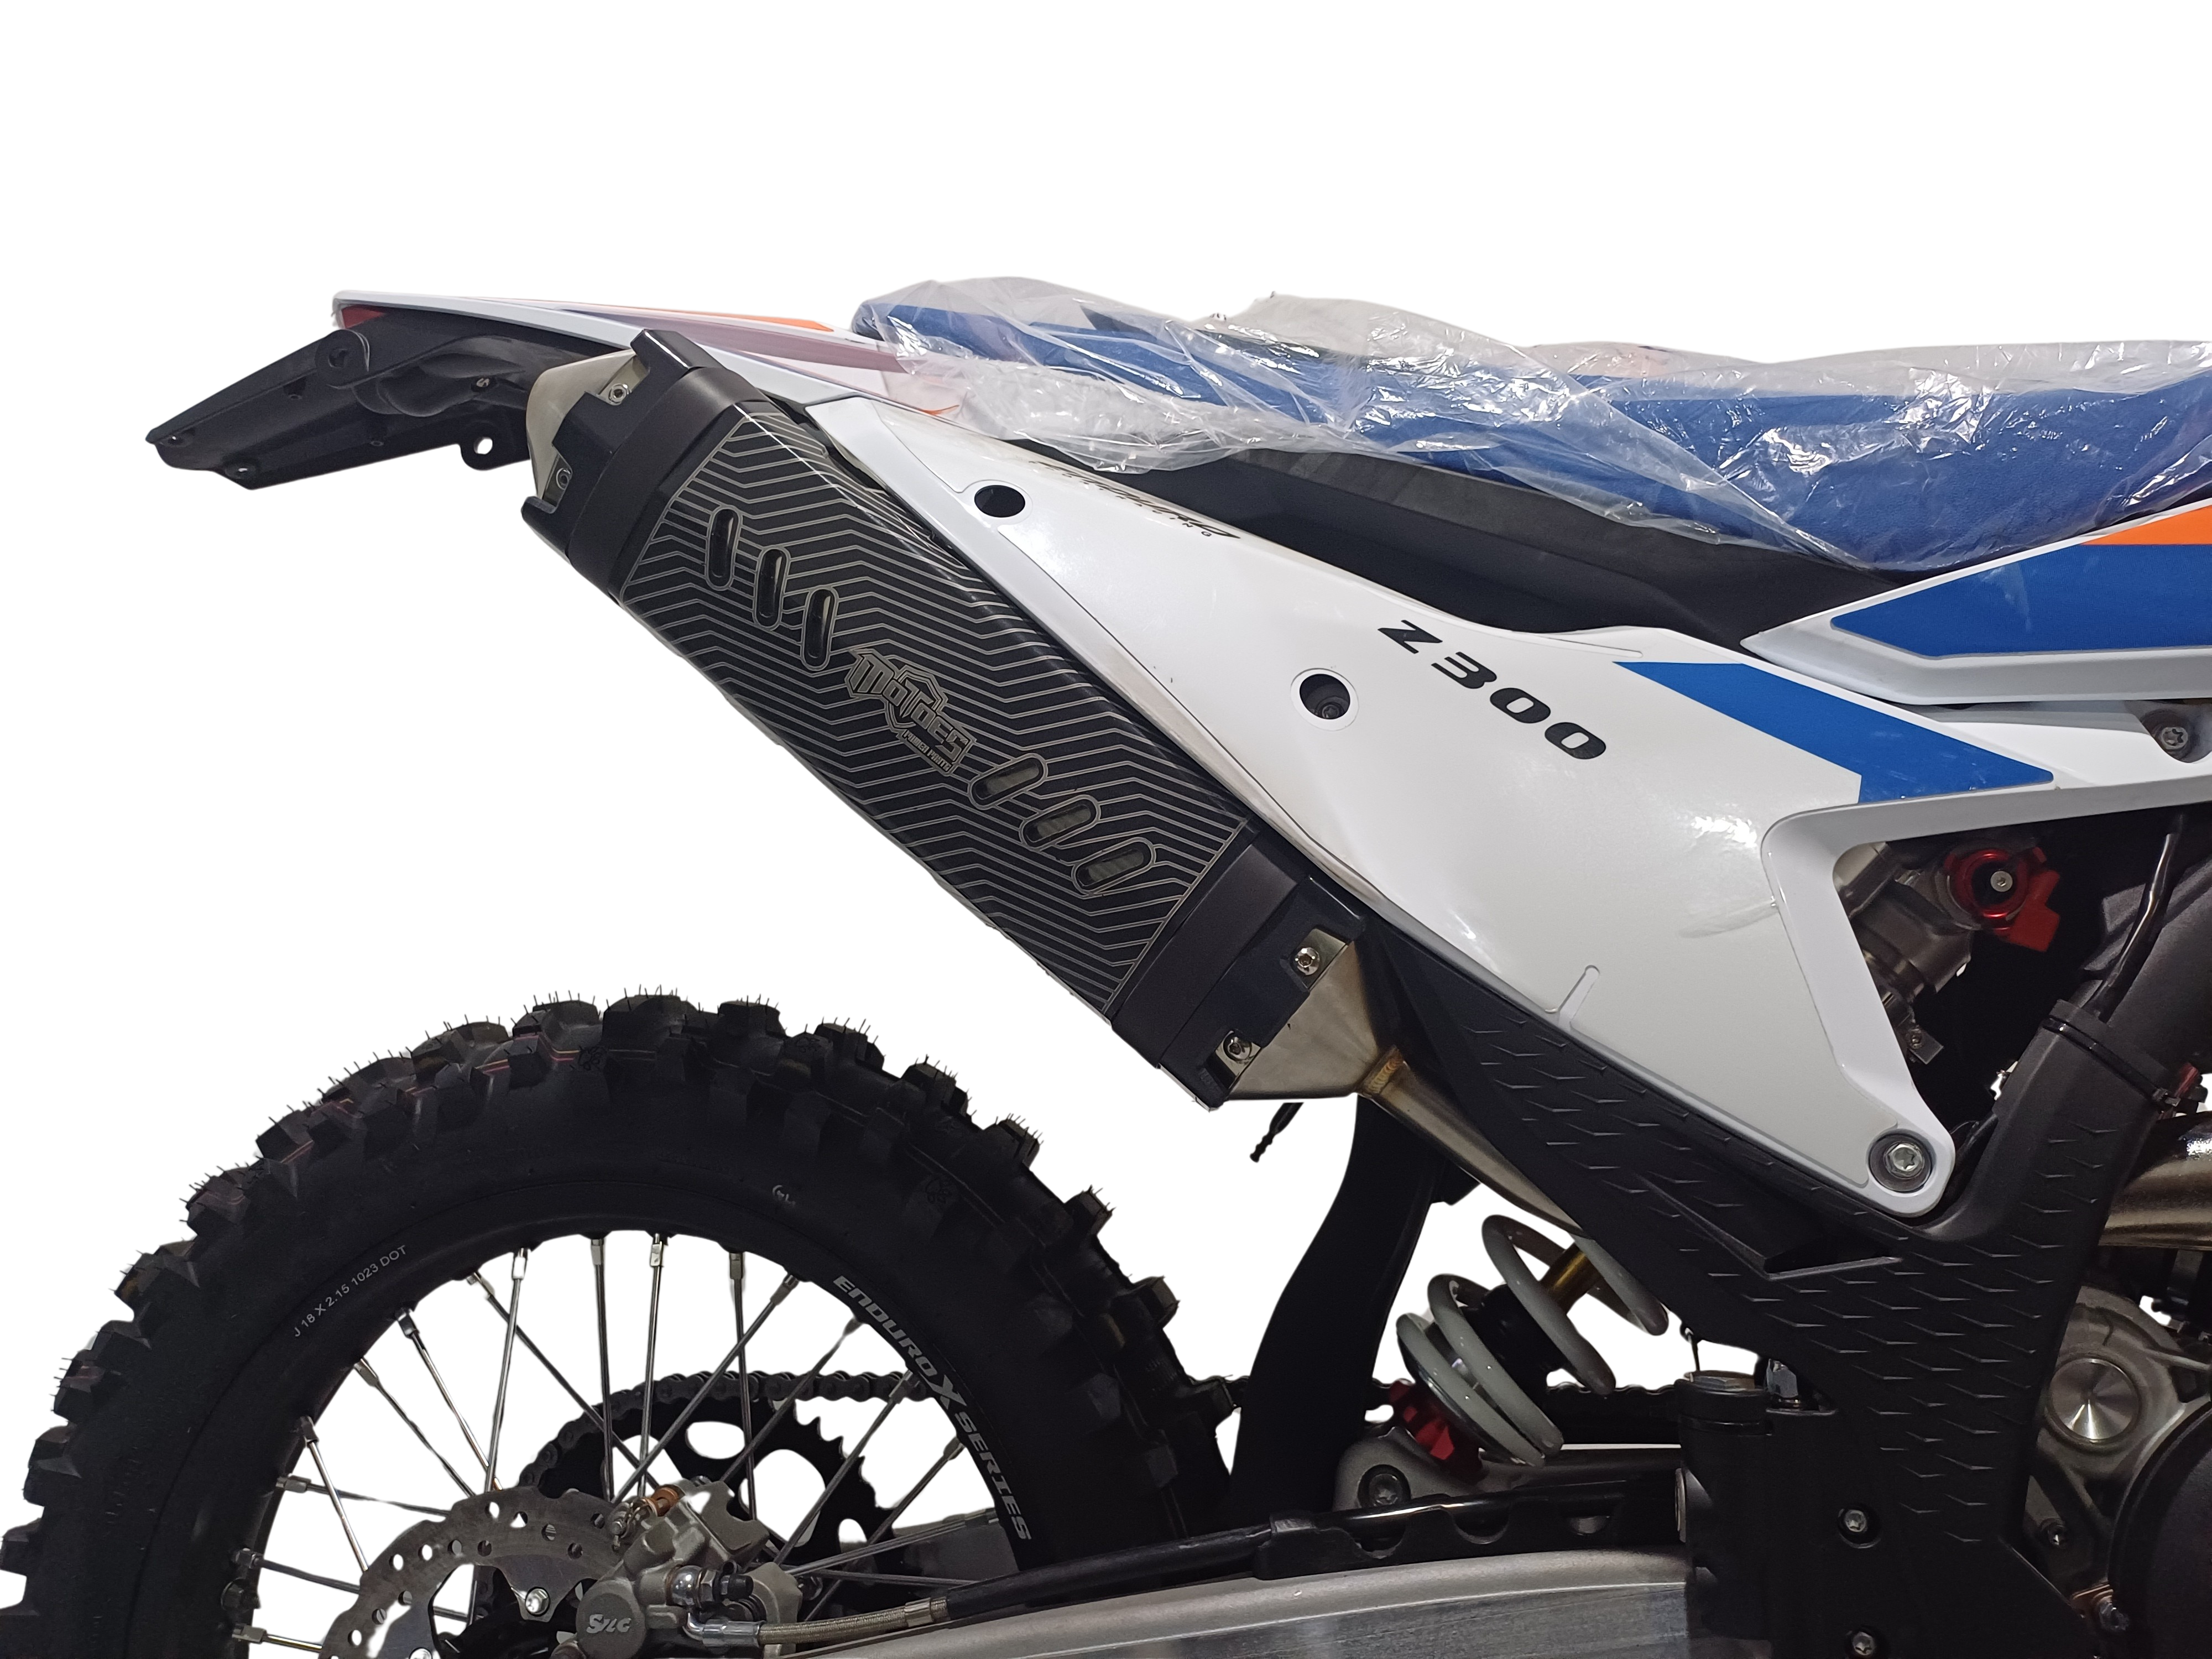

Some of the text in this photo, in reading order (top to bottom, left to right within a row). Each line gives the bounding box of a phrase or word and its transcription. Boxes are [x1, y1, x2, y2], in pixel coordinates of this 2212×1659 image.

[294, 1244, 406, 1337] J 18 X 2.15 1023 DOT
[954, 1411, 1032, 1540] SERIES
